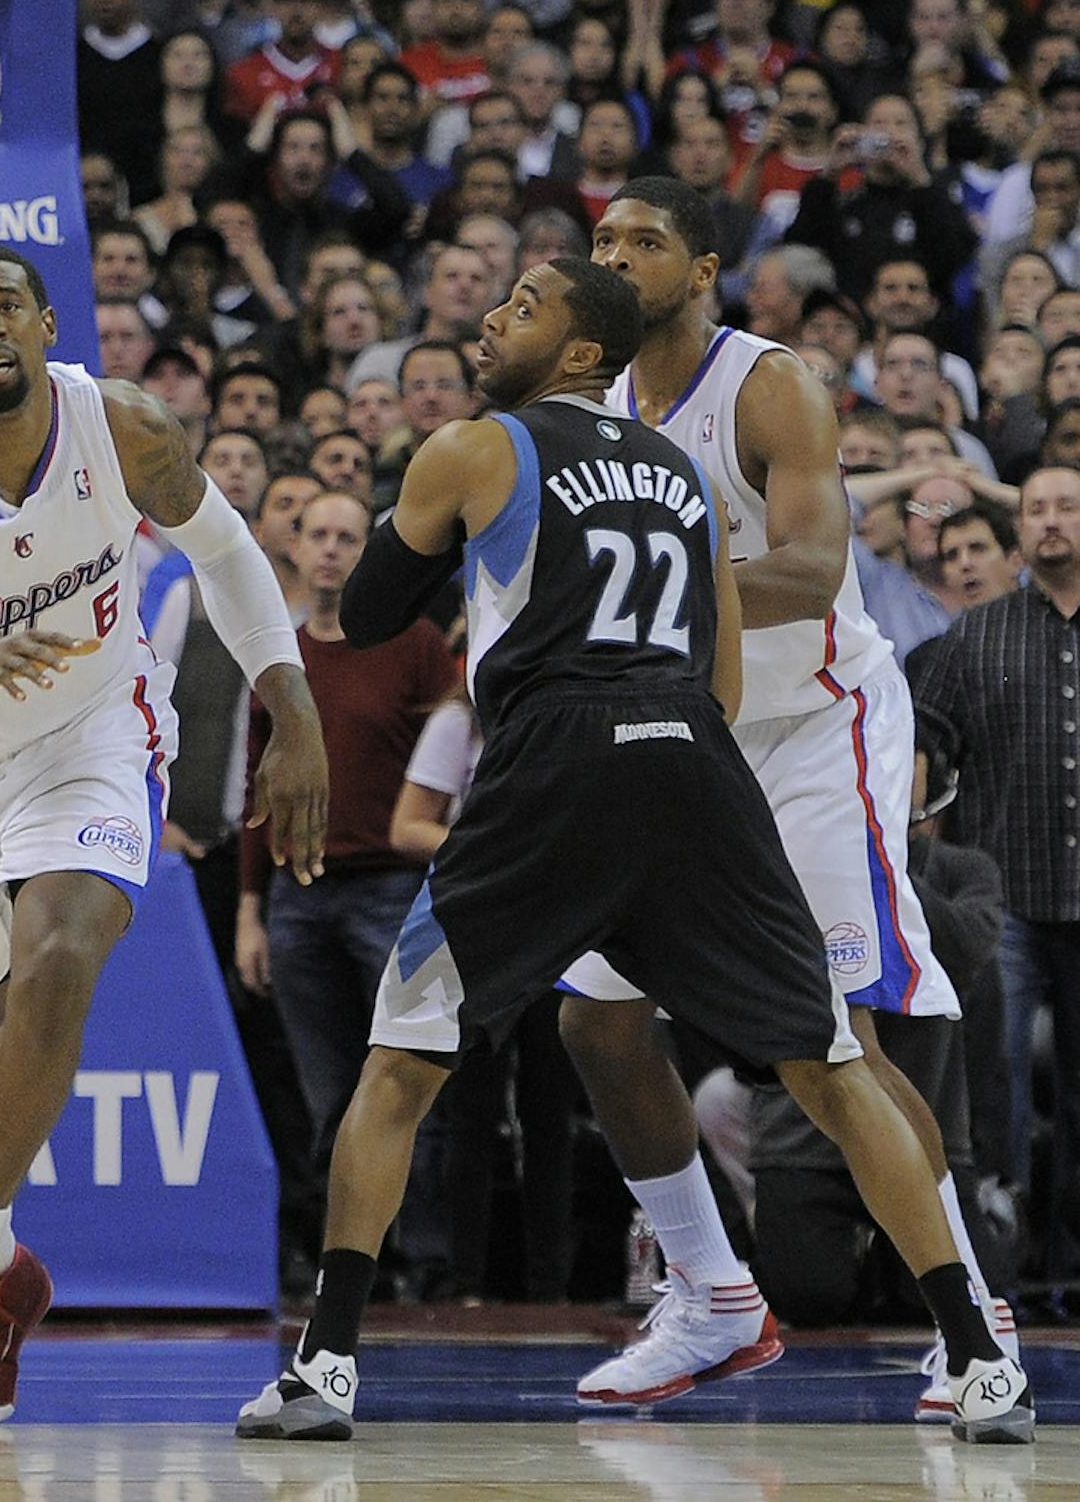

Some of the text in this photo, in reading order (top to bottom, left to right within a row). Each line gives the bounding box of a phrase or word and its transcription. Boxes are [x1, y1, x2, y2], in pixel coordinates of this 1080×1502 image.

[546, 458, 707, 529] ELLINGTON
[93, 580, 120, 639] 6
[584, 529, 691, 658] 22
[614, 721, 695, 745] MINNESOTA
[74, 1071, 220, 1186] TV
